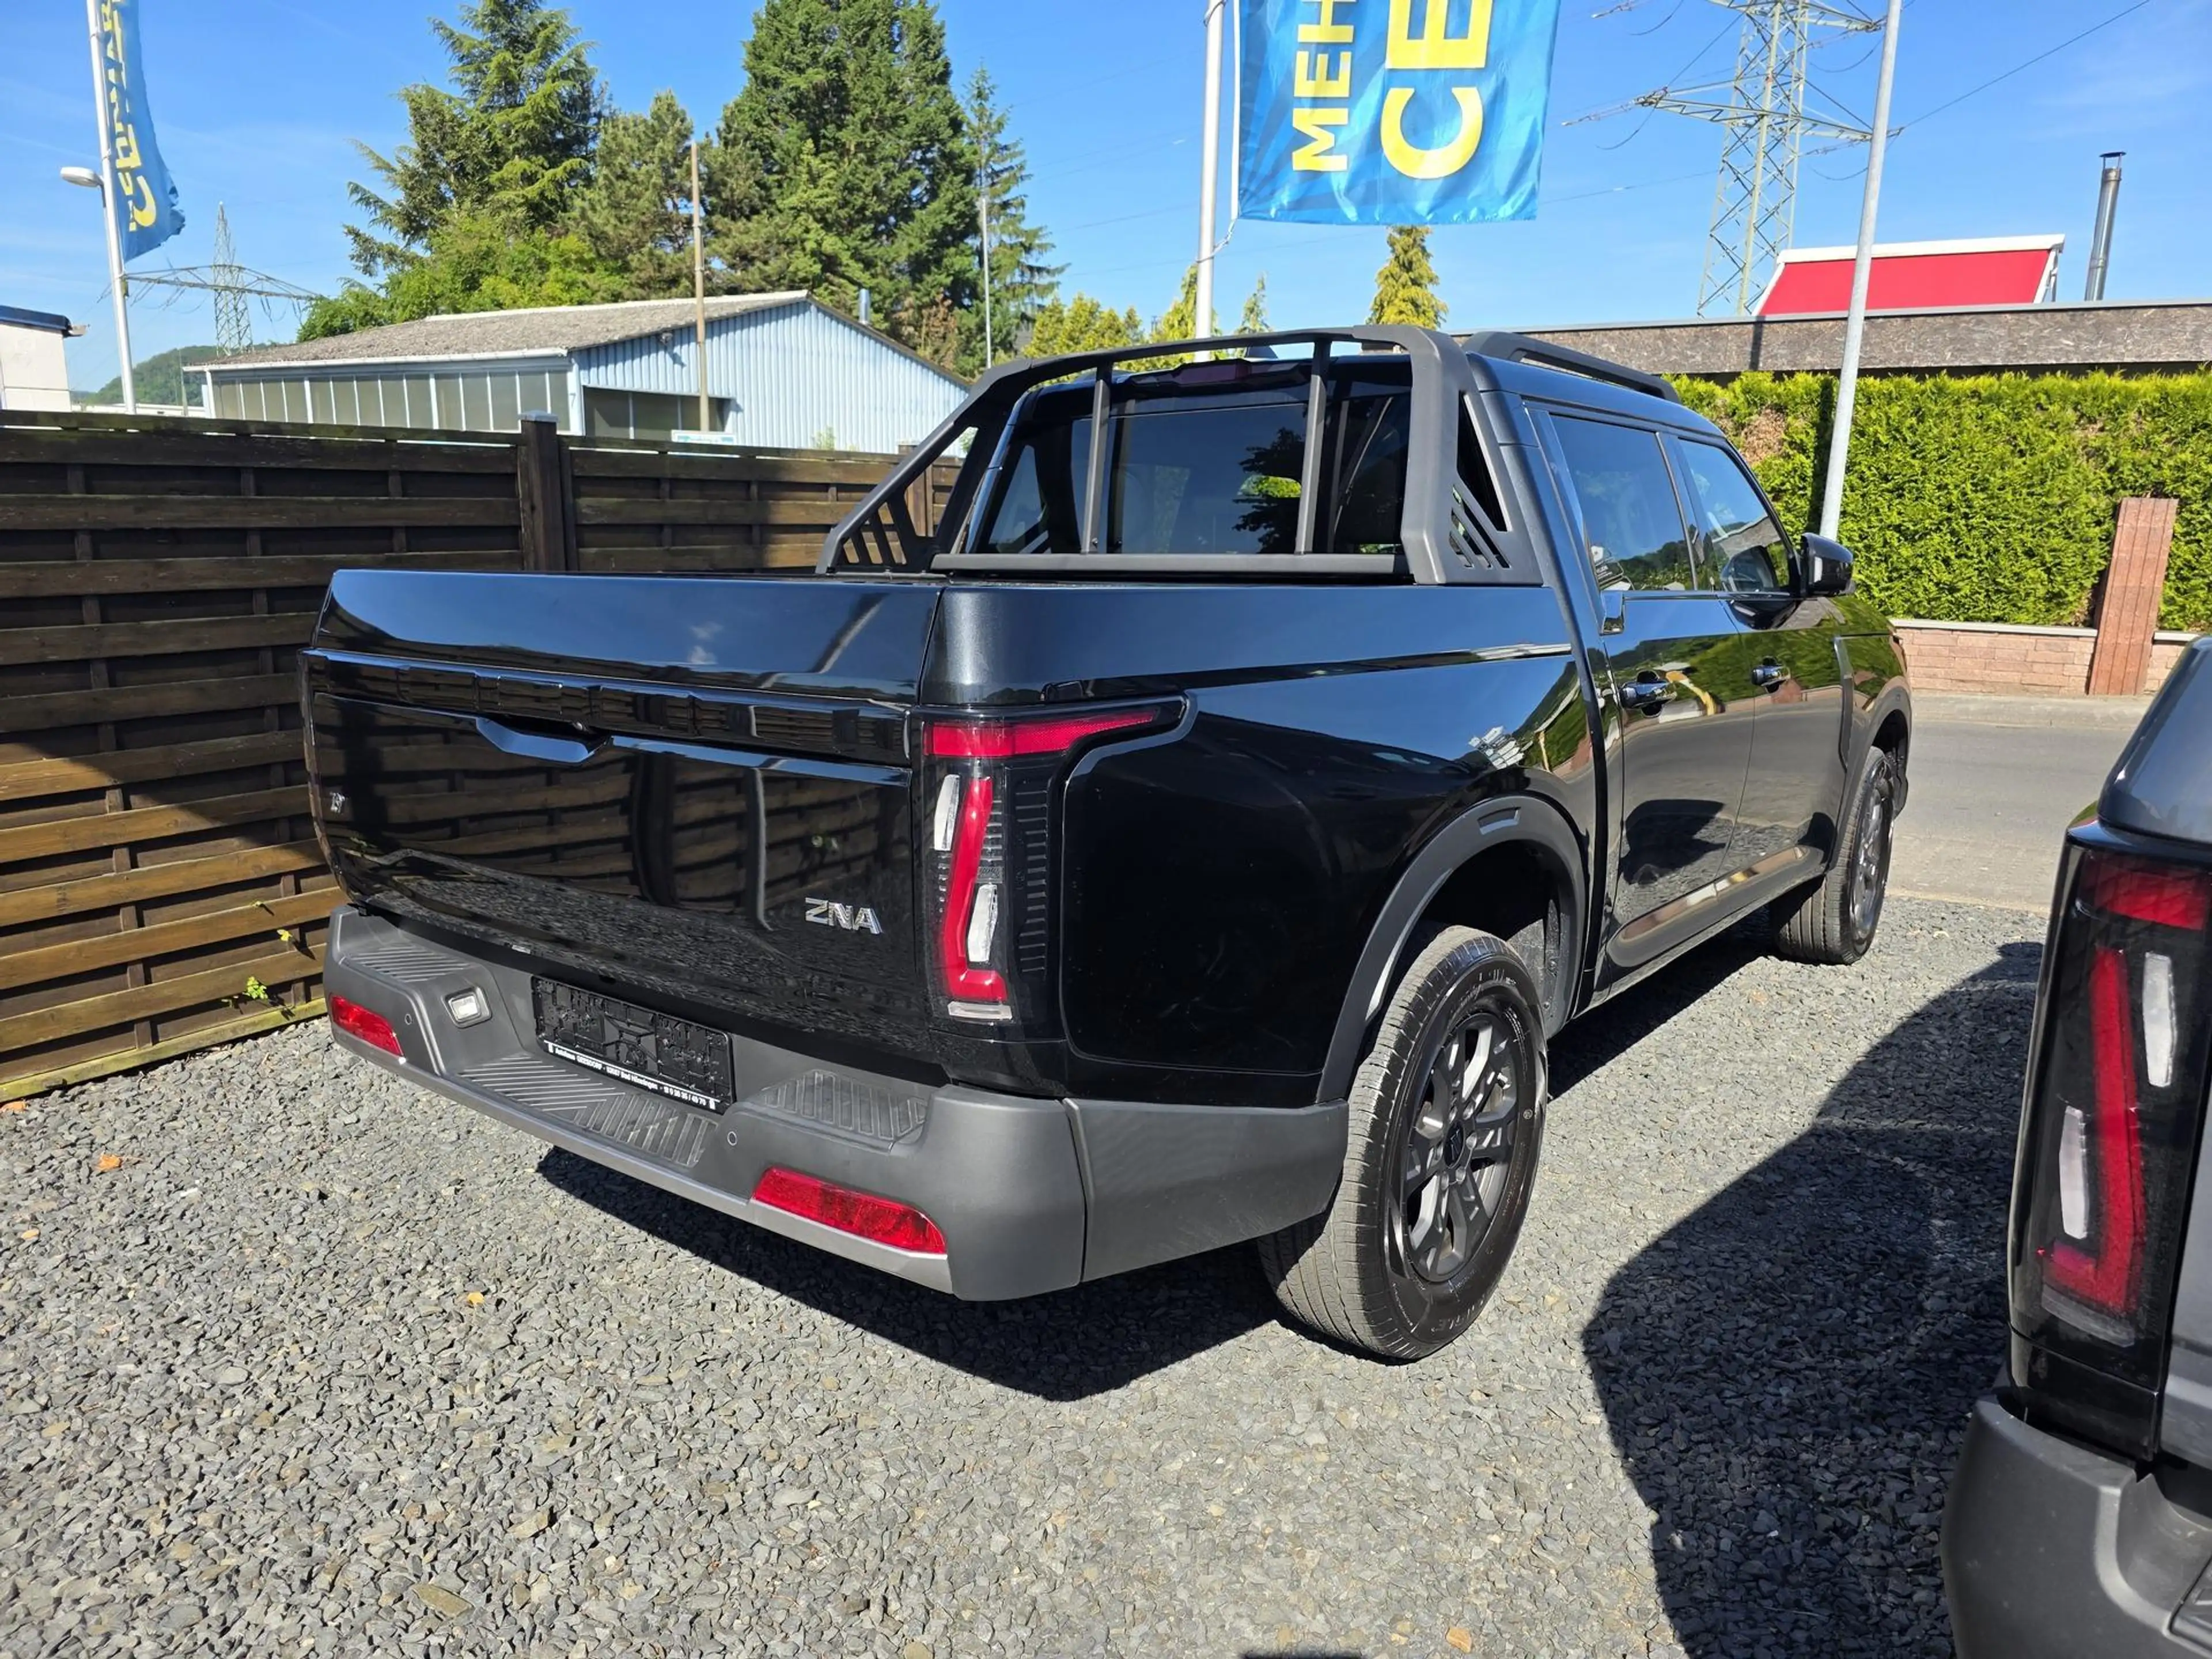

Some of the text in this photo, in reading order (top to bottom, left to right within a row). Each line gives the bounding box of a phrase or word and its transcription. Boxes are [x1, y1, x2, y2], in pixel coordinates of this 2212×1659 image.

[1292, 0, 1354, 171] MEH
[1380, 0, 1493, 180] CE
[805, 897, 882, 934] ZNA
